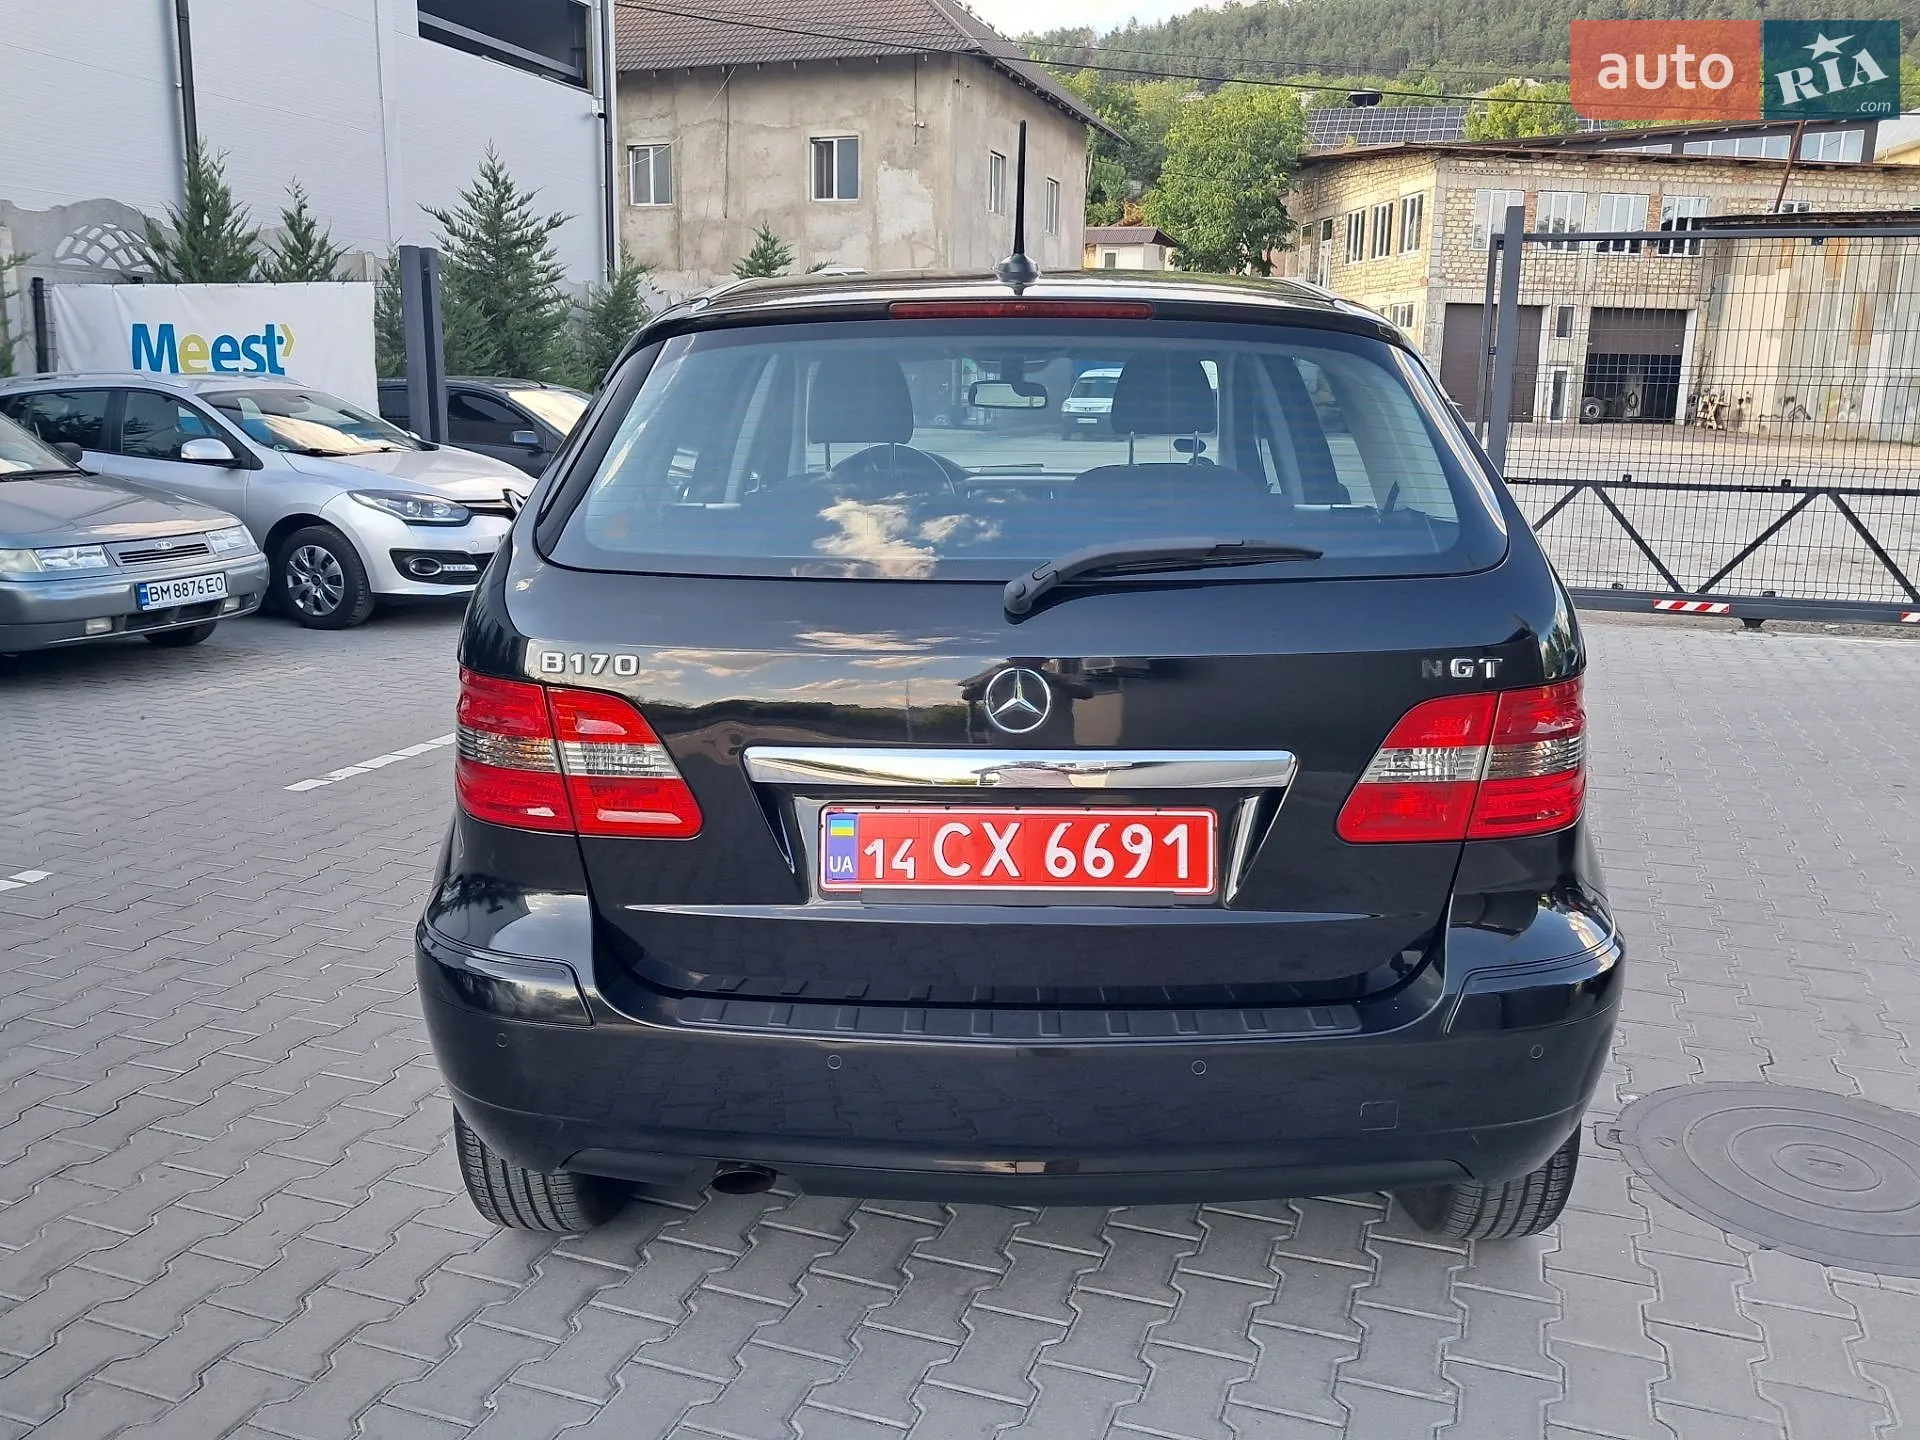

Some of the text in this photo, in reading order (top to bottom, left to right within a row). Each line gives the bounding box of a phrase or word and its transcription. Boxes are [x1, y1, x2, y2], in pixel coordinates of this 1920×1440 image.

[132, 323, 286, 376] Meest
[149, 585, 171, 602] BM
[173, 580, 204, 598] 8876
[541, 651, 639, 675] B170
[1422, 658, 1503, 679] NGT
[864, 821, 1188, 880] 14 CX 6691
[829, 855, 854, 873] UA
